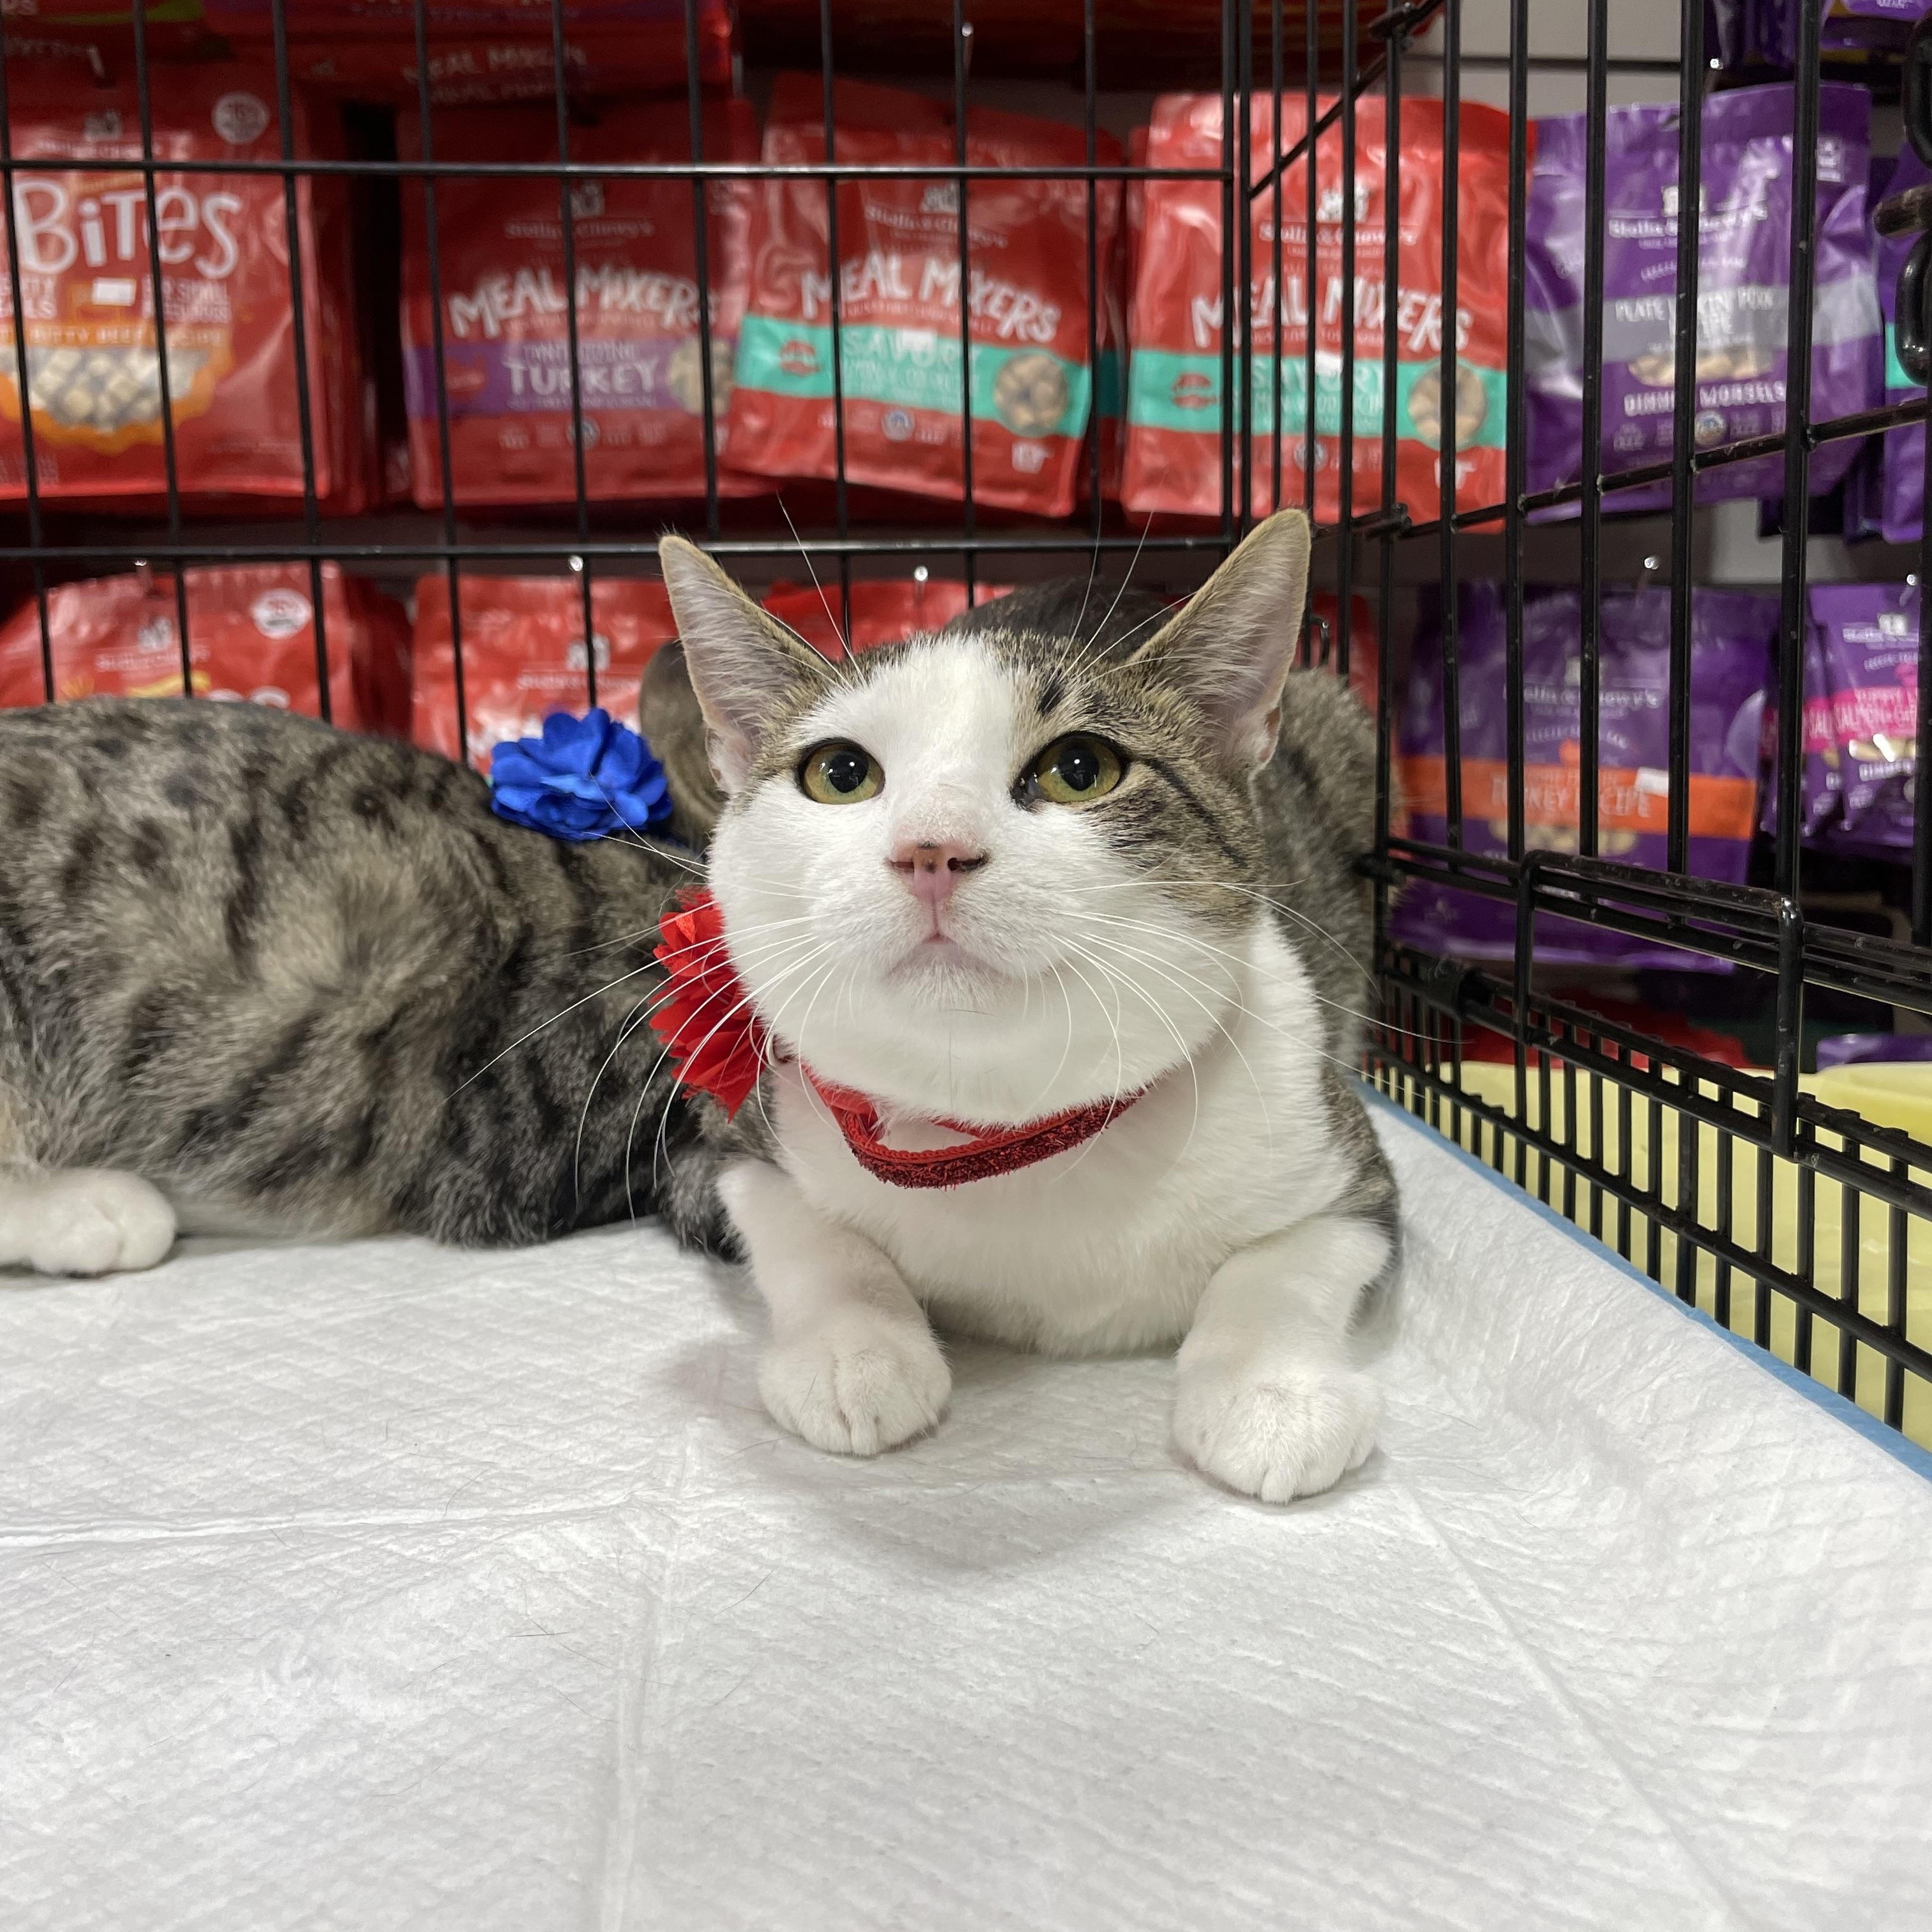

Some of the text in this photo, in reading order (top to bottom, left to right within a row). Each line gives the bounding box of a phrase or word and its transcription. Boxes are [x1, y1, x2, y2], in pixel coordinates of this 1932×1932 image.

[449, 262, 569, 338] MEAL
[801, 250, 912, 319] MEAL
[917, 257, 1062, 342] MXERS
[503, 358, 661, 397] TURKEY
[1490, 774, 1574, 814] TKEY
